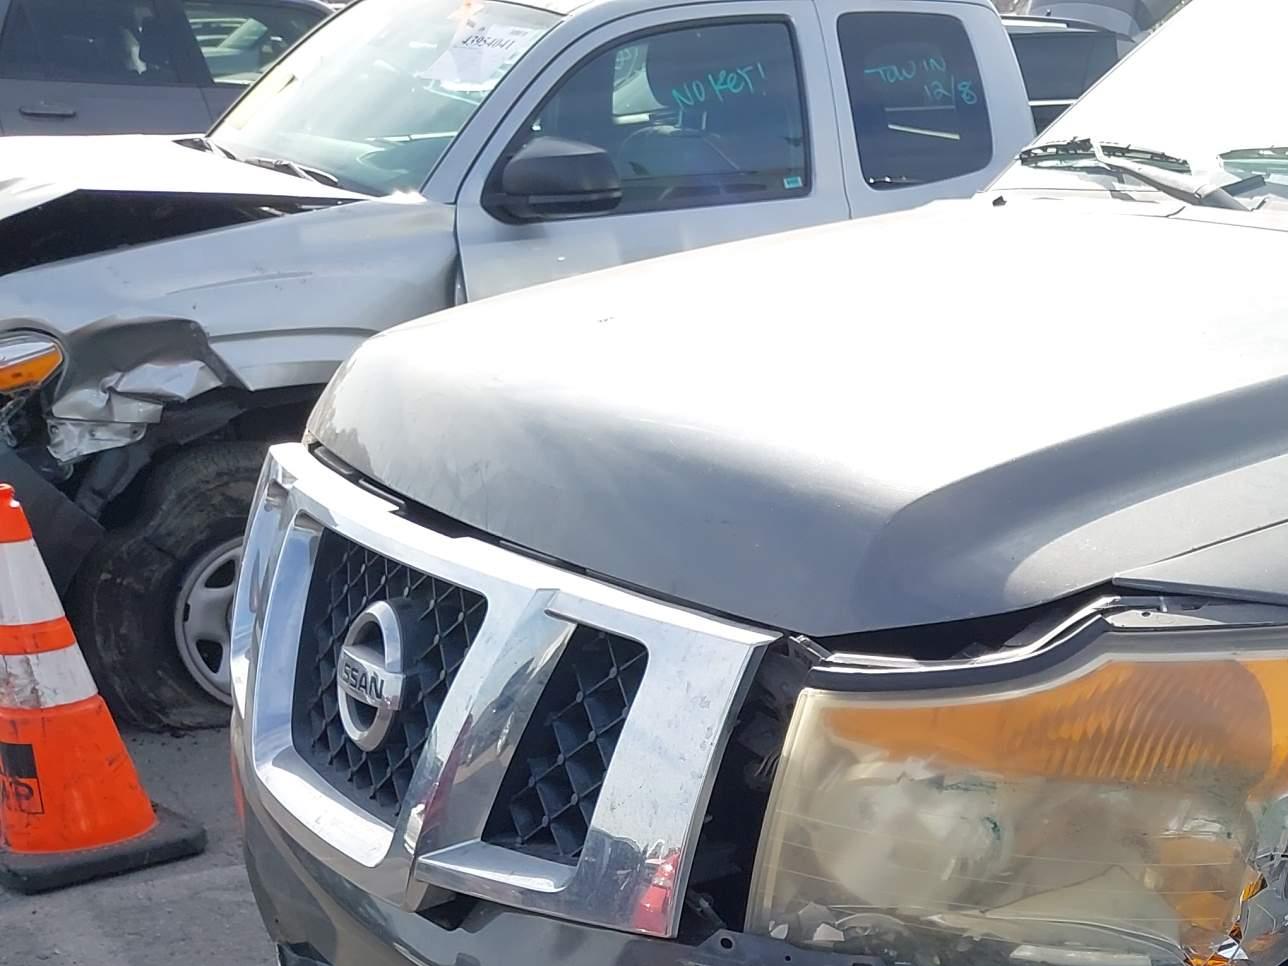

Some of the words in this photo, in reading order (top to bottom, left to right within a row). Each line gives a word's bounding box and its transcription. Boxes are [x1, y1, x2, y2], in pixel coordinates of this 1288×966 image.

[922, 57, 947, 73] IN
[671, 79, 706, 110] NO
[923, 75, 978, 105] 12/8
[341, 662, 386, 700] SSAN
